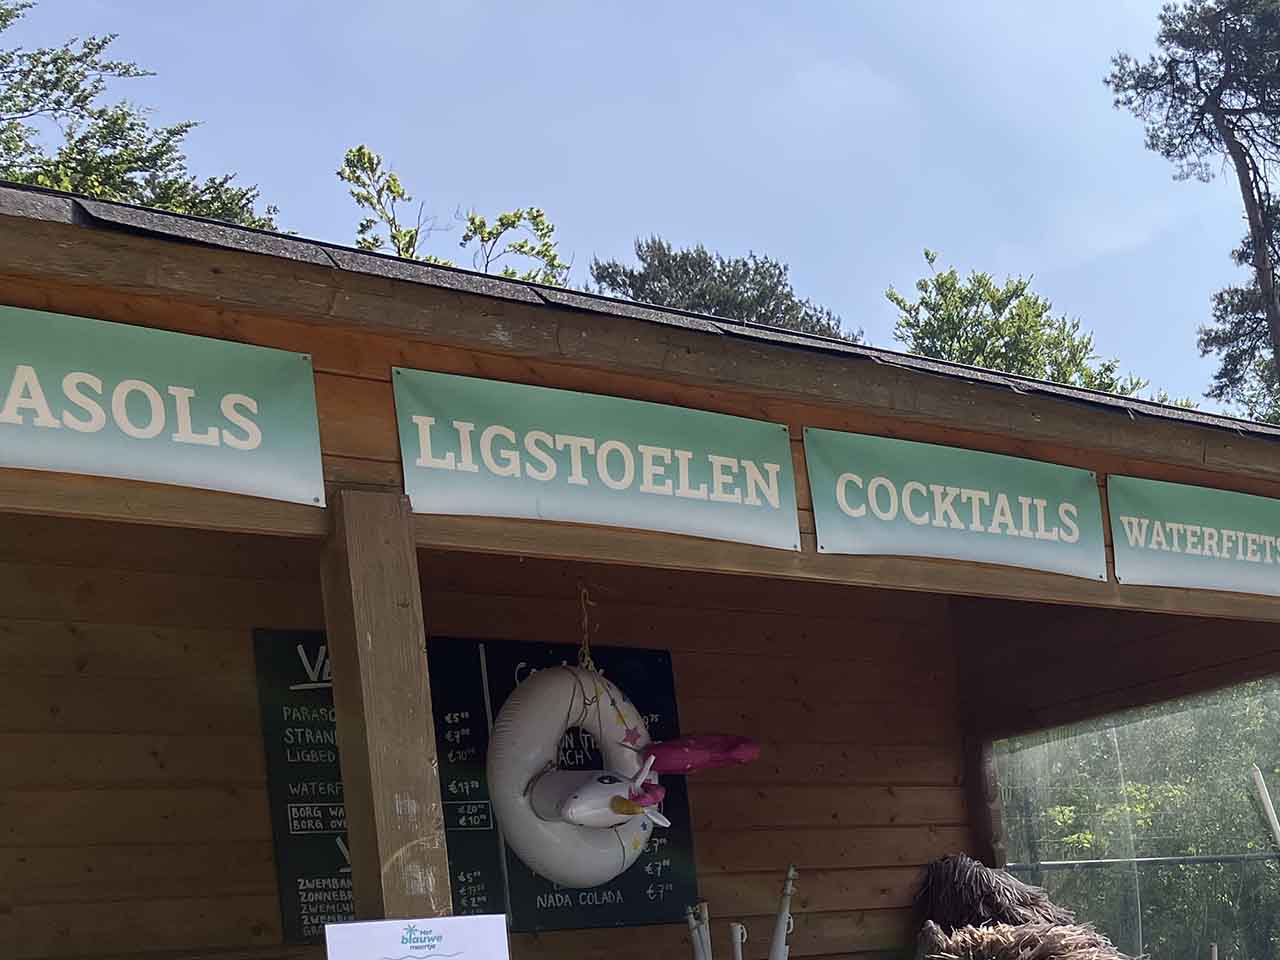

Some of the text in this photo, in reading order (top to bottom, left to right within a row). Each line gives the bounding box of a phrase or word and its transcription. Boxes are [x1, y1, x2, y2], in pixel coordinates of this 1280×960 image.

[0, 364, 262, 450] ASOLS
[412, 415, 781, 509] LIGSTOELEN
[835, 472, 1080, 544] COCKTAILS
[282, 706, 336, 722] PARASO
[284, 728, 336, 745] STRAN
[288, 782, 344, 796] WATERF
[291, 807, 344, 818] BORG WA
[293, 819, 323, 830] BORG
[297, 878, 352, 890] ZWEMBAN
[298, 890, 352, 903] ZONNEBR
[536, 890, 624, 909] NADA COLADA
[401, 933, 443, 944] blauwe
